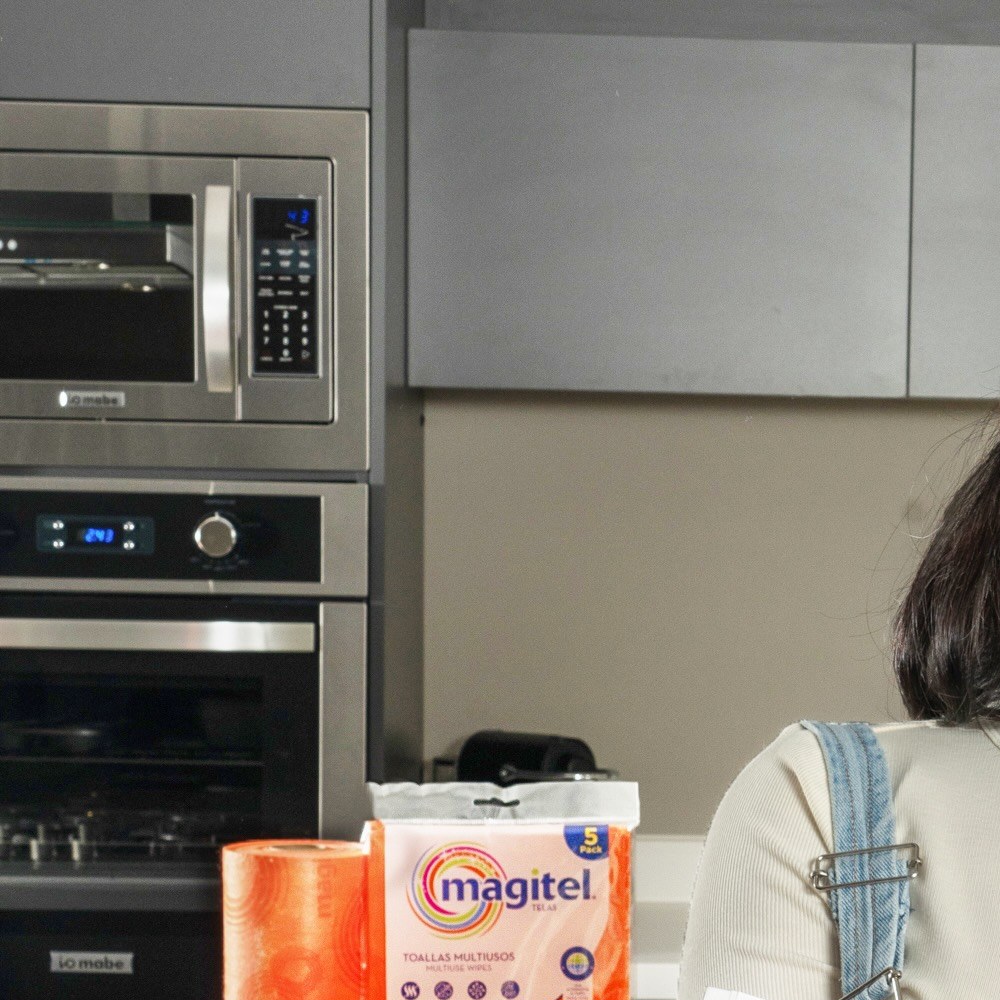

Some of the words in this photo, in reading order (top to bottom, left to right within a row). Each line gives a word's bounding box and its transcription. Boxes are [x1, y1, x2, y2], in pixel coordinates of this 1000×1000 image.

[583, 826, 599, 846] 5
[579, 845, 603, 854] Pack
[441, 867, 591, 910] magitel
[79, 955, 124, 970] mabe
[403, 952, 451, 962] TOALLAS
[454, 951, 516, 962] MULTIUSOS
[425, 964, 465, 973] MULTIUSE
[467, 964, 493, 972] WIPES
